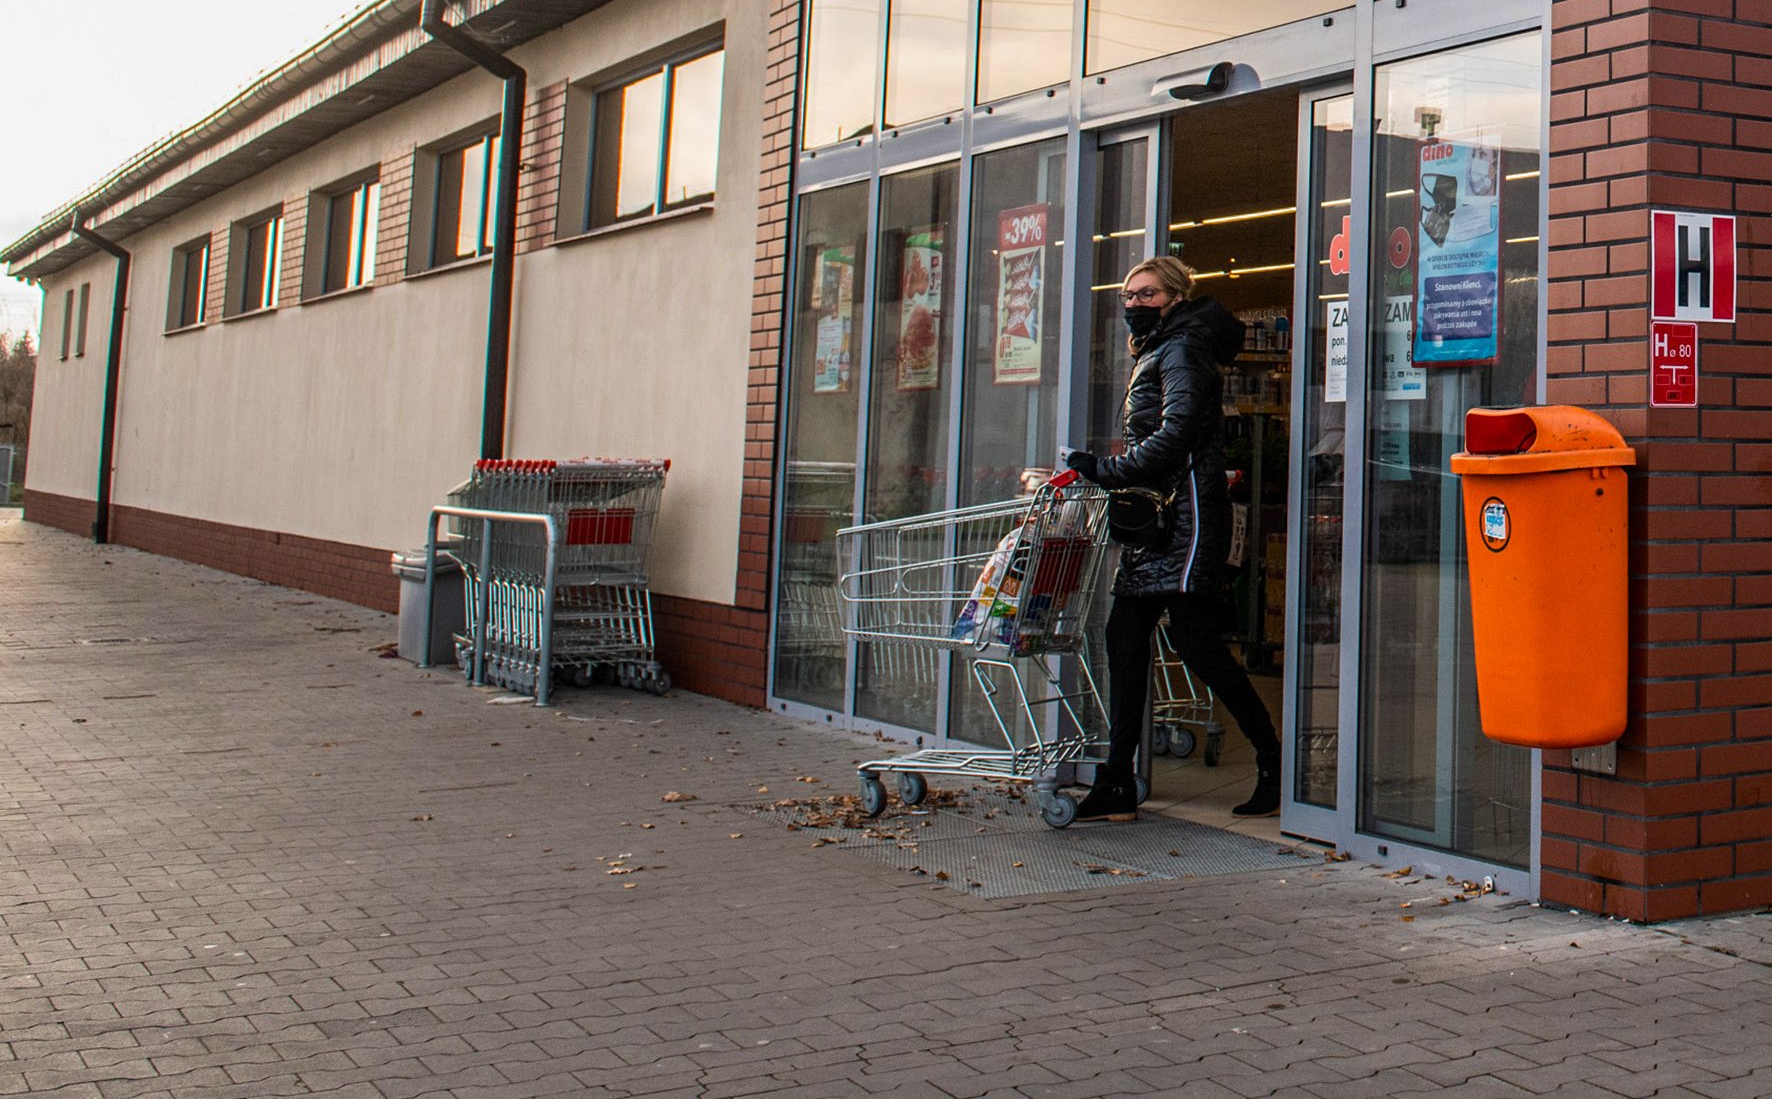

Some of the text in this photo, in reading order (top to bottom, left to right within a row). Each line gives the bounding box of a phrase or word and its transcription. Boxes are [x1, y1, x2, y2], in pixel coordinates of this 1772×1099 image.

[1678, 225, 1711, 308] H
[1654, 333, 1668, 358] H
[1679, 344, 1692, 358] 80
